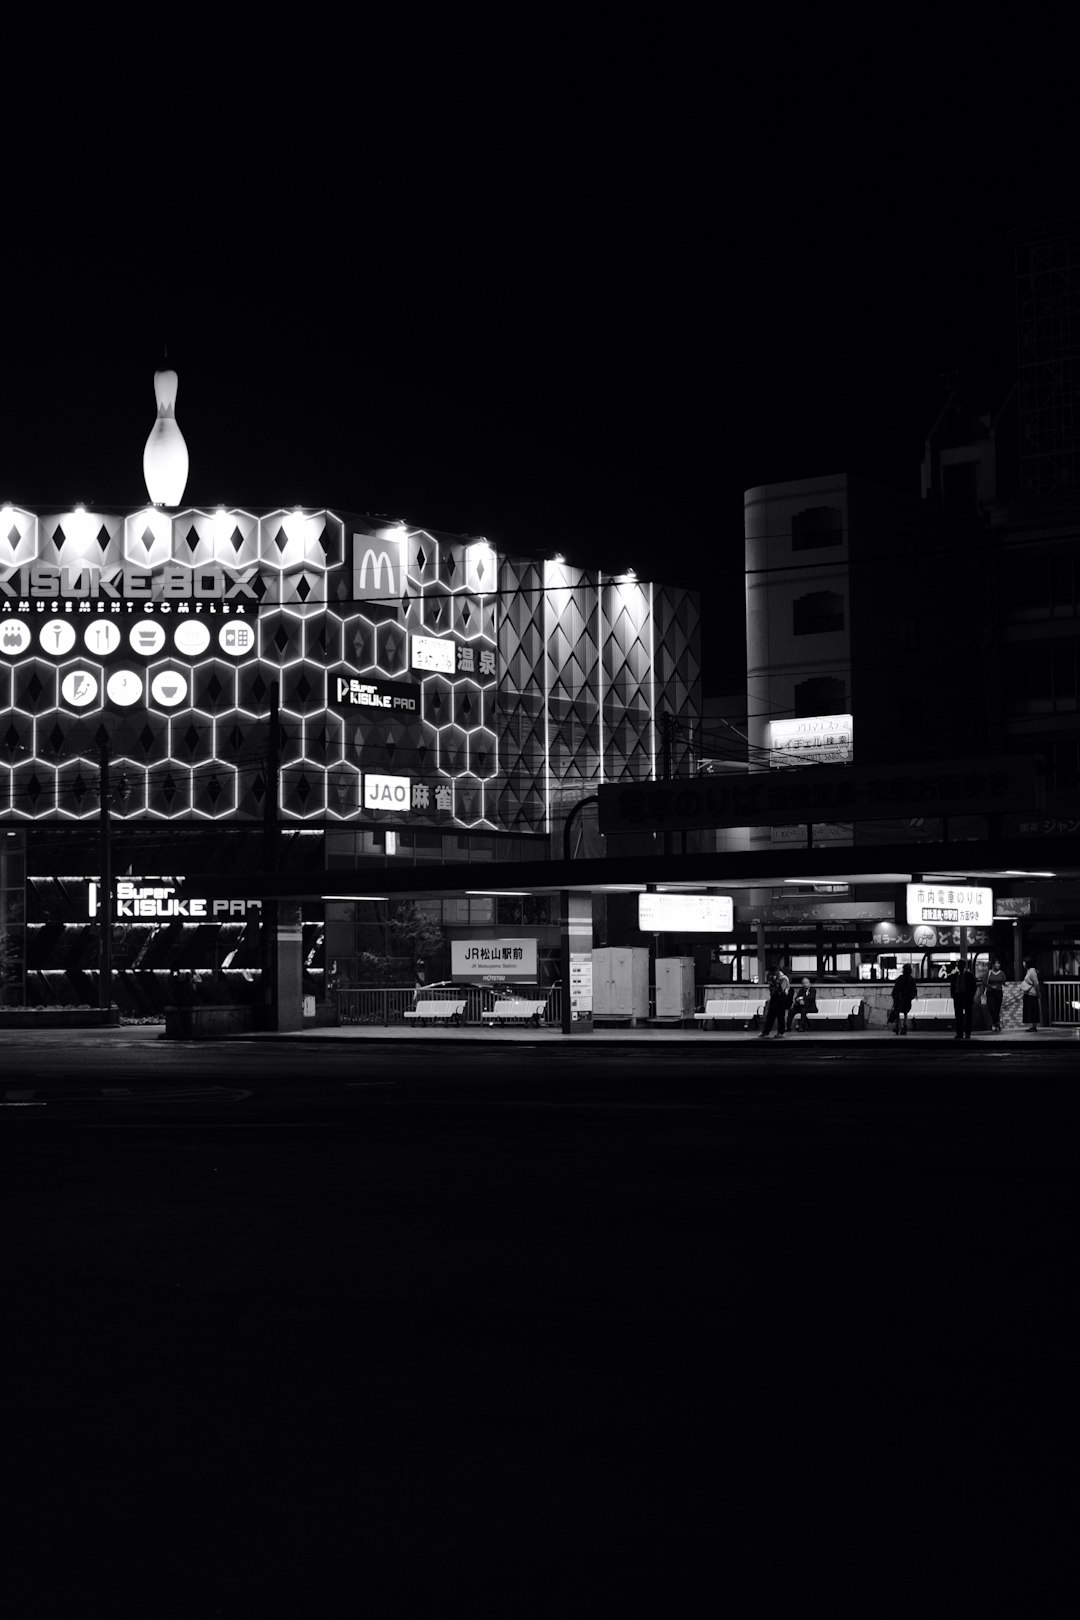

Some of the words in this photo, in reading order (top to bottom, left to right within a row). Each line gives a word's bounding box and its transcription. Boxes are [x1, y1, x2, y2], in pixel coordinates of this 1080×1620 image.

[0, 567, 152, 598] KISUKE
[163, 567, 259, 598] BOX
[3, 600, 134, 613] AMUSEMENT
[457, 646, 496, 675] 温泉
[350, 679, 378, 694] Super
[350, 691, 392, 708] KISUKE
[369, 783, 406, 802] JAO
[411, 783, 451, 810] 麻雀
[117, 882, 175, 900] Super
[917, 889, 983, 905] 市内電車のりば
[117, 899, 207, 917] KISUKE
[465, 947, 523, 960] JR松山駅前
